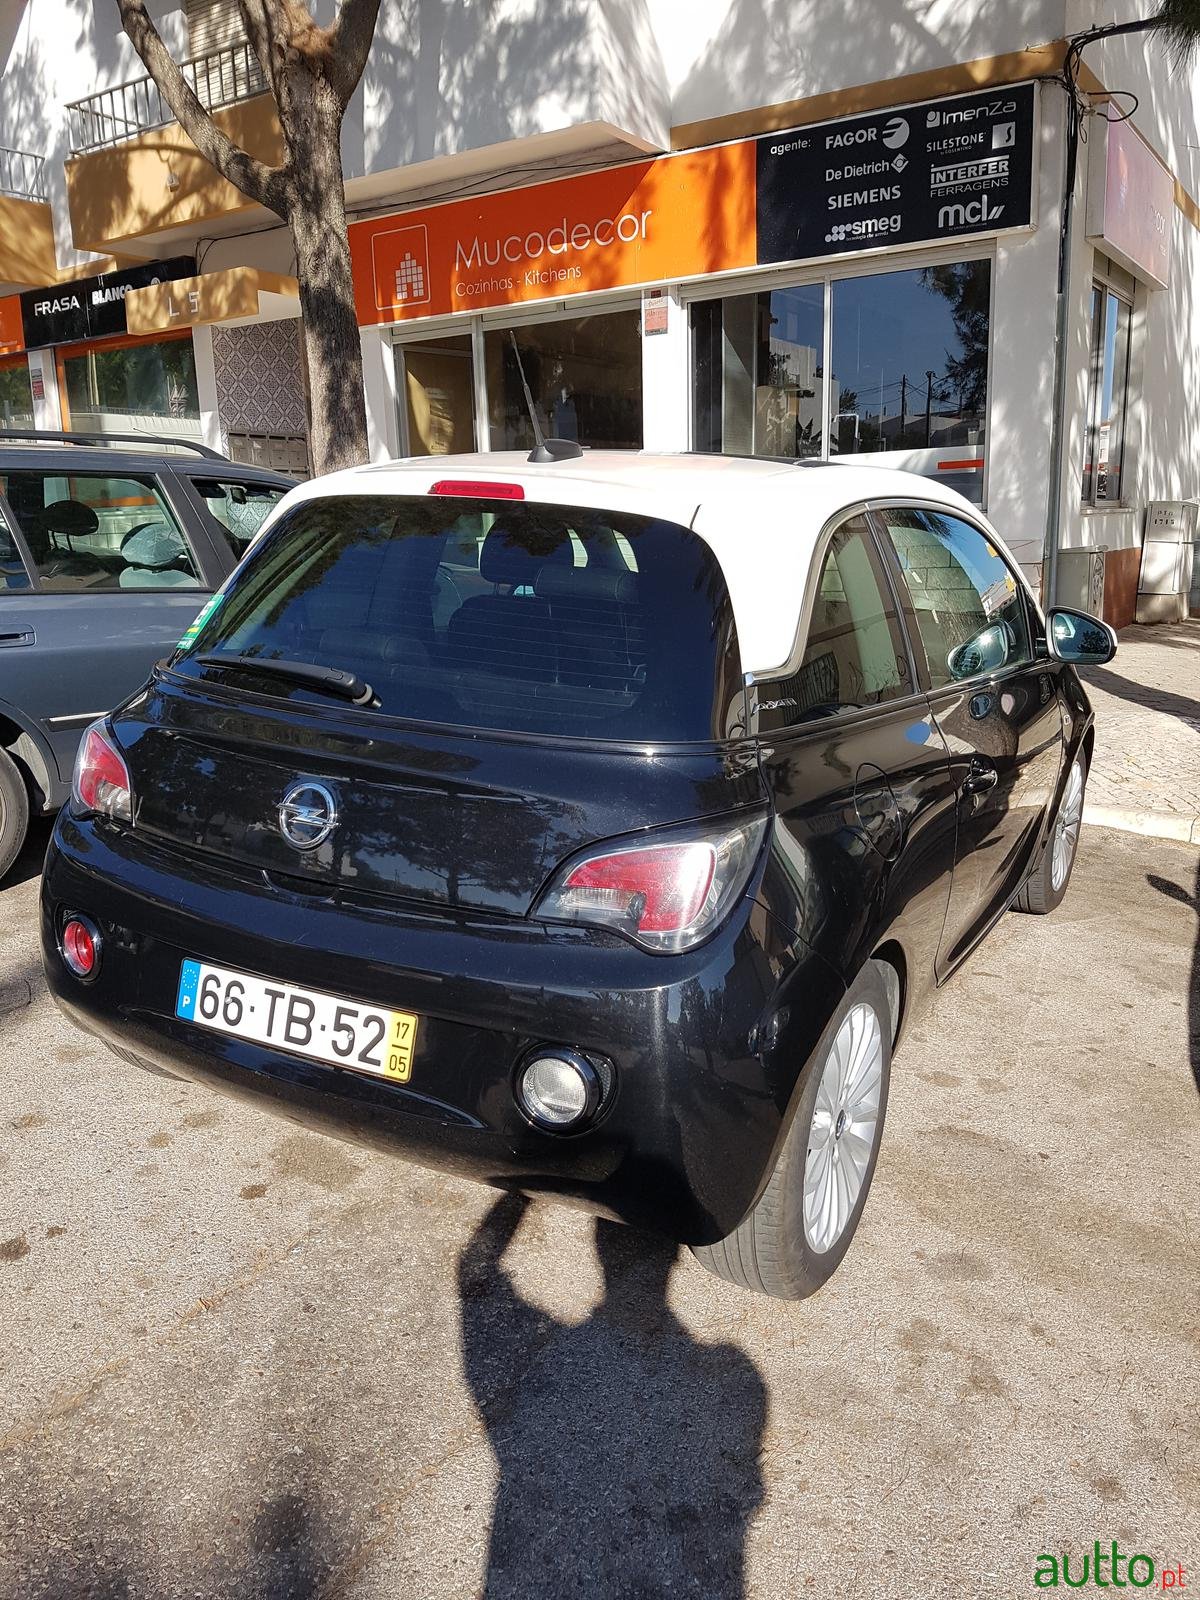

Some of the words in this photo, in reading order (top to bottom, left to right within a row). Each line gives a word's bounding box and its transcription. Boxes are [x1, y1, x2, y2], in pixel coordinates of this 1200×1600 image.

[770, 139, 811, 156] agente:
[826, 127, 877, 150] FAGOR
[926, 132, 984, 153] SILESTONE
[825, 169, 842, 182] De
[844, 160, 890, 179] Dietrich
[828, 185, 901, 210] SIEMENS
[930, 177, 1009, 198] FERRAGENS
[851, 214, 902, 235] smeg
[455, 210, 652, 272] Mucodecor
[455, 277, 513, 297] Cozinhas
[524, 265, 582, 287] Kitchens
[34, 295, 81, 316] FRASA
[168, 296, 180, 317] L
[182, 995, 191, 1008] P
[395, 1021, 410, 1040] 17
[389, 1054, 407, 1074] 05
